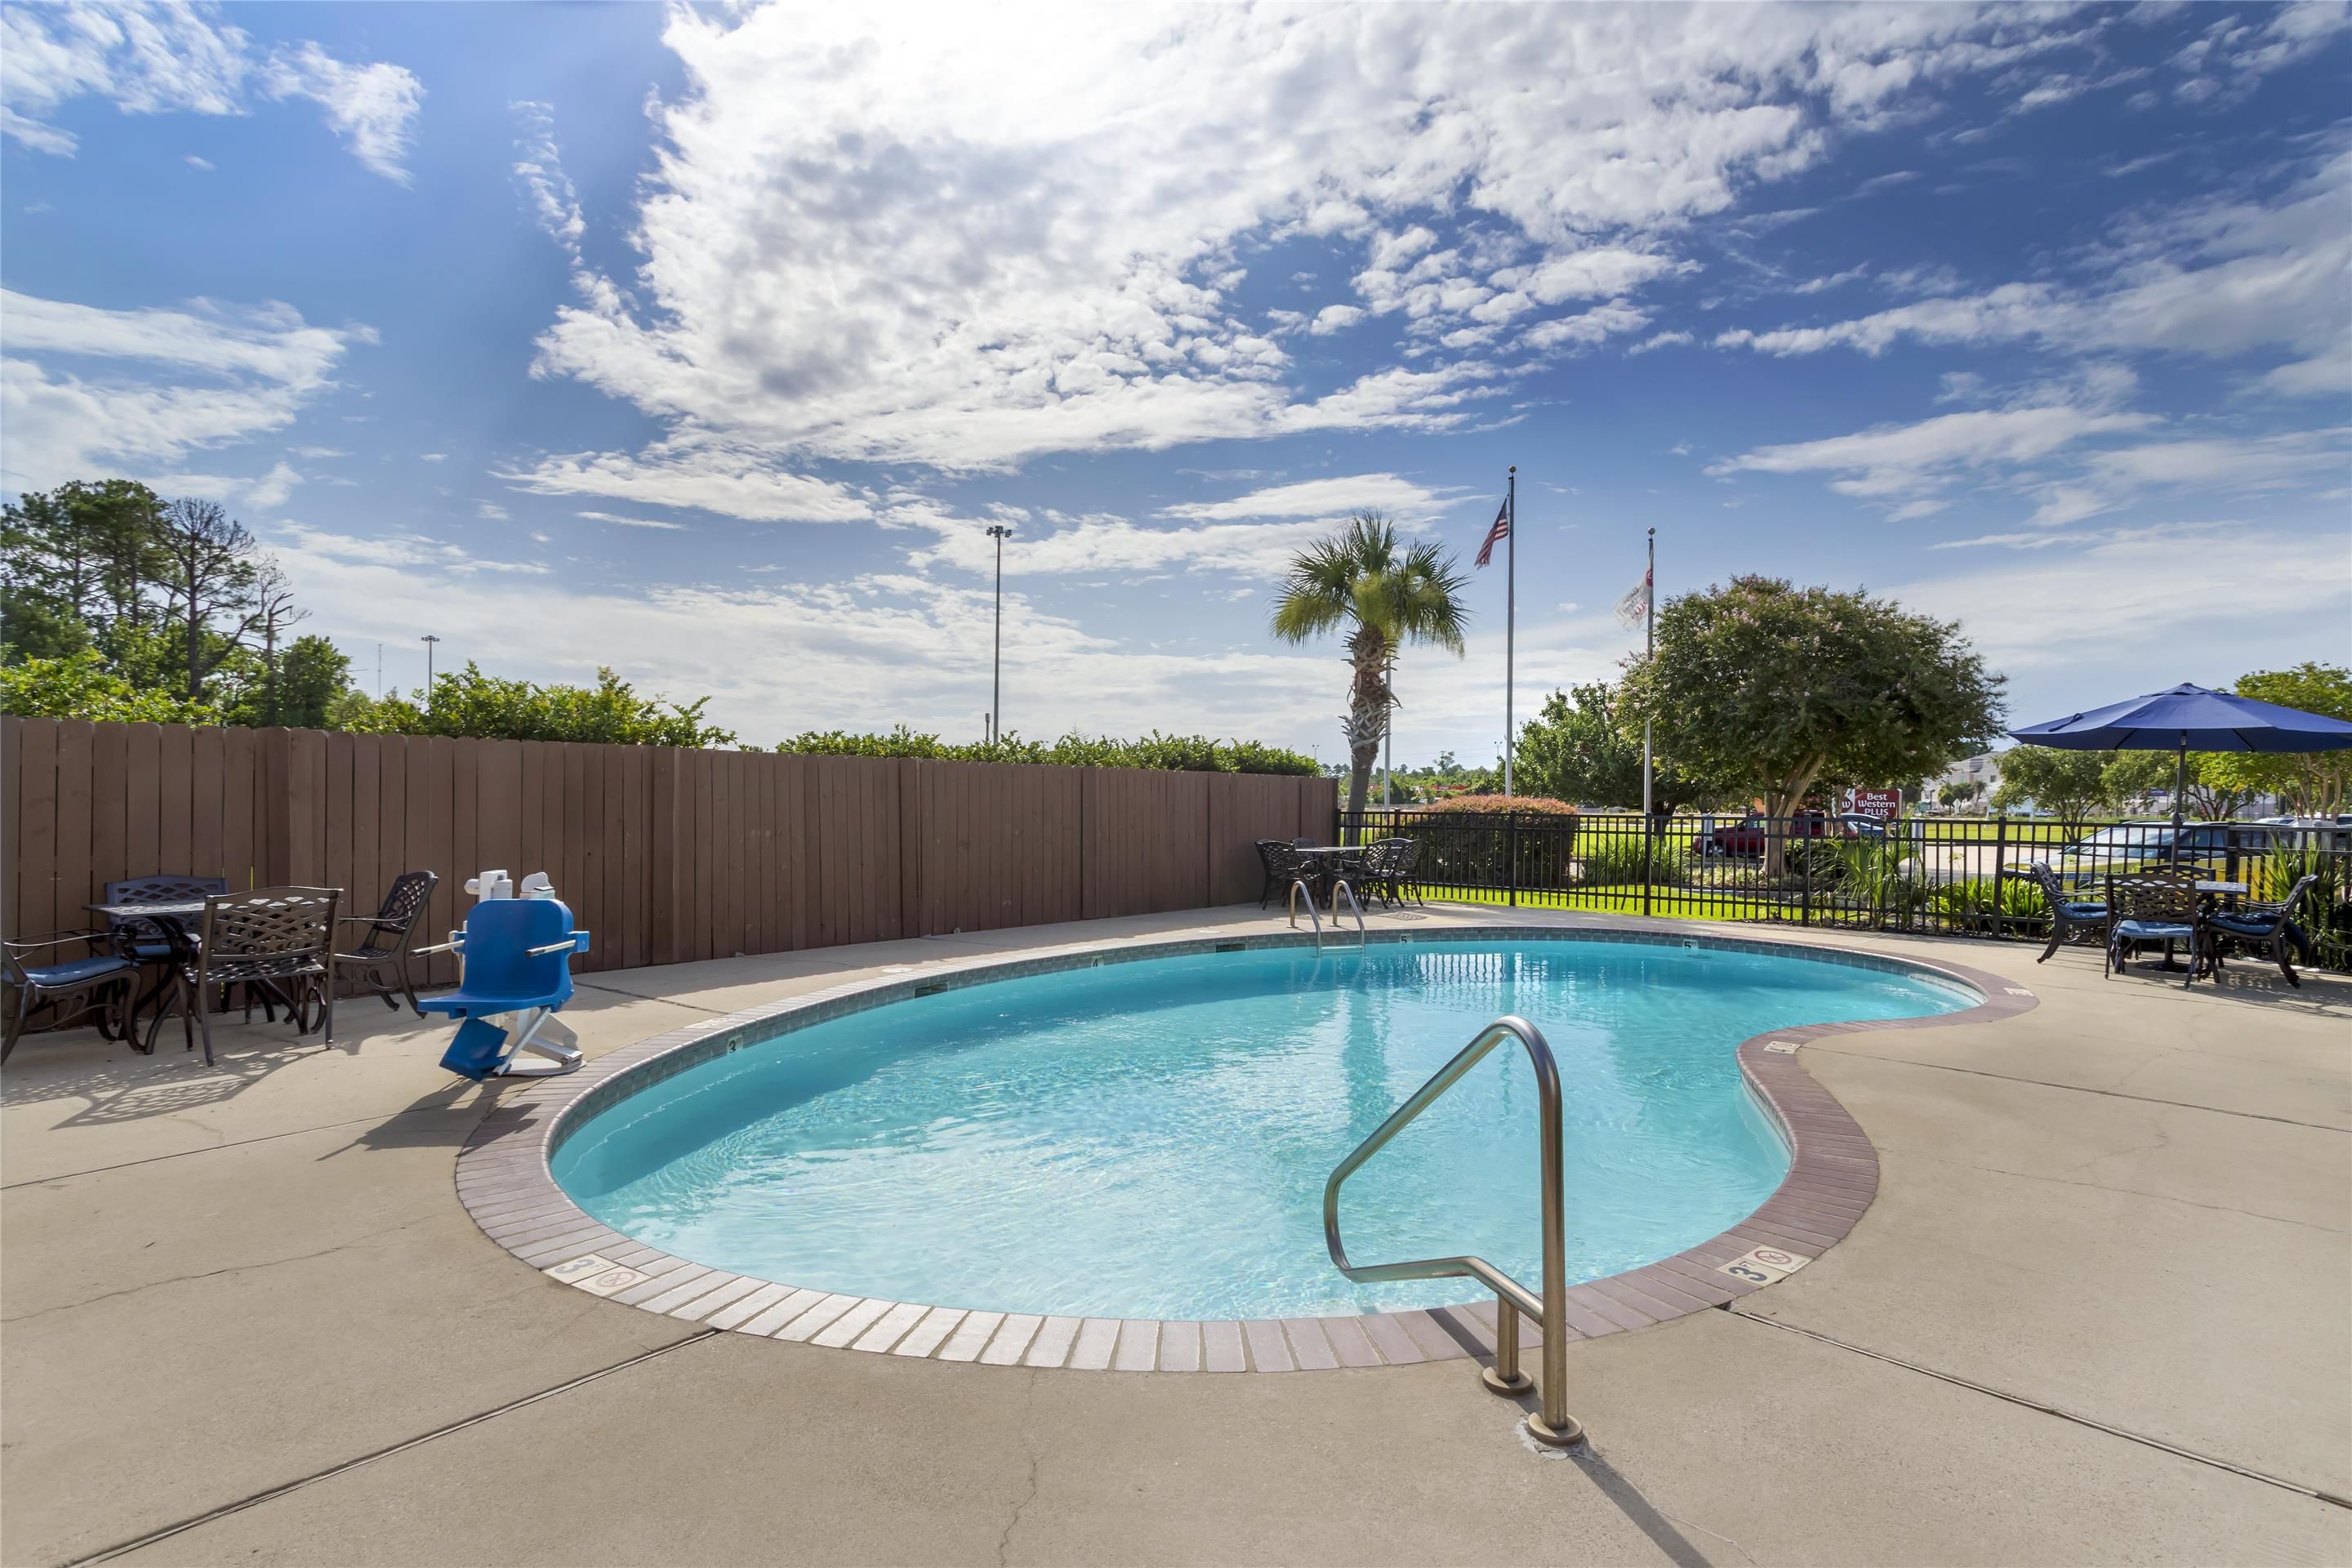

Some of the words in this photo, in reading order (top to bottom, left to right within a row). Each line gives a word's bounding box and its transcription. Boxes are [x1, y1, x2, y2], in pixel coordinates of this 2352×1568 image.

[1858, 800, 1895, 808] Western
[728, 1040, 737, 1054] 3
[555, 1258, 595, 1274] 3
[1728, 1267, 1768, 1281] 3
